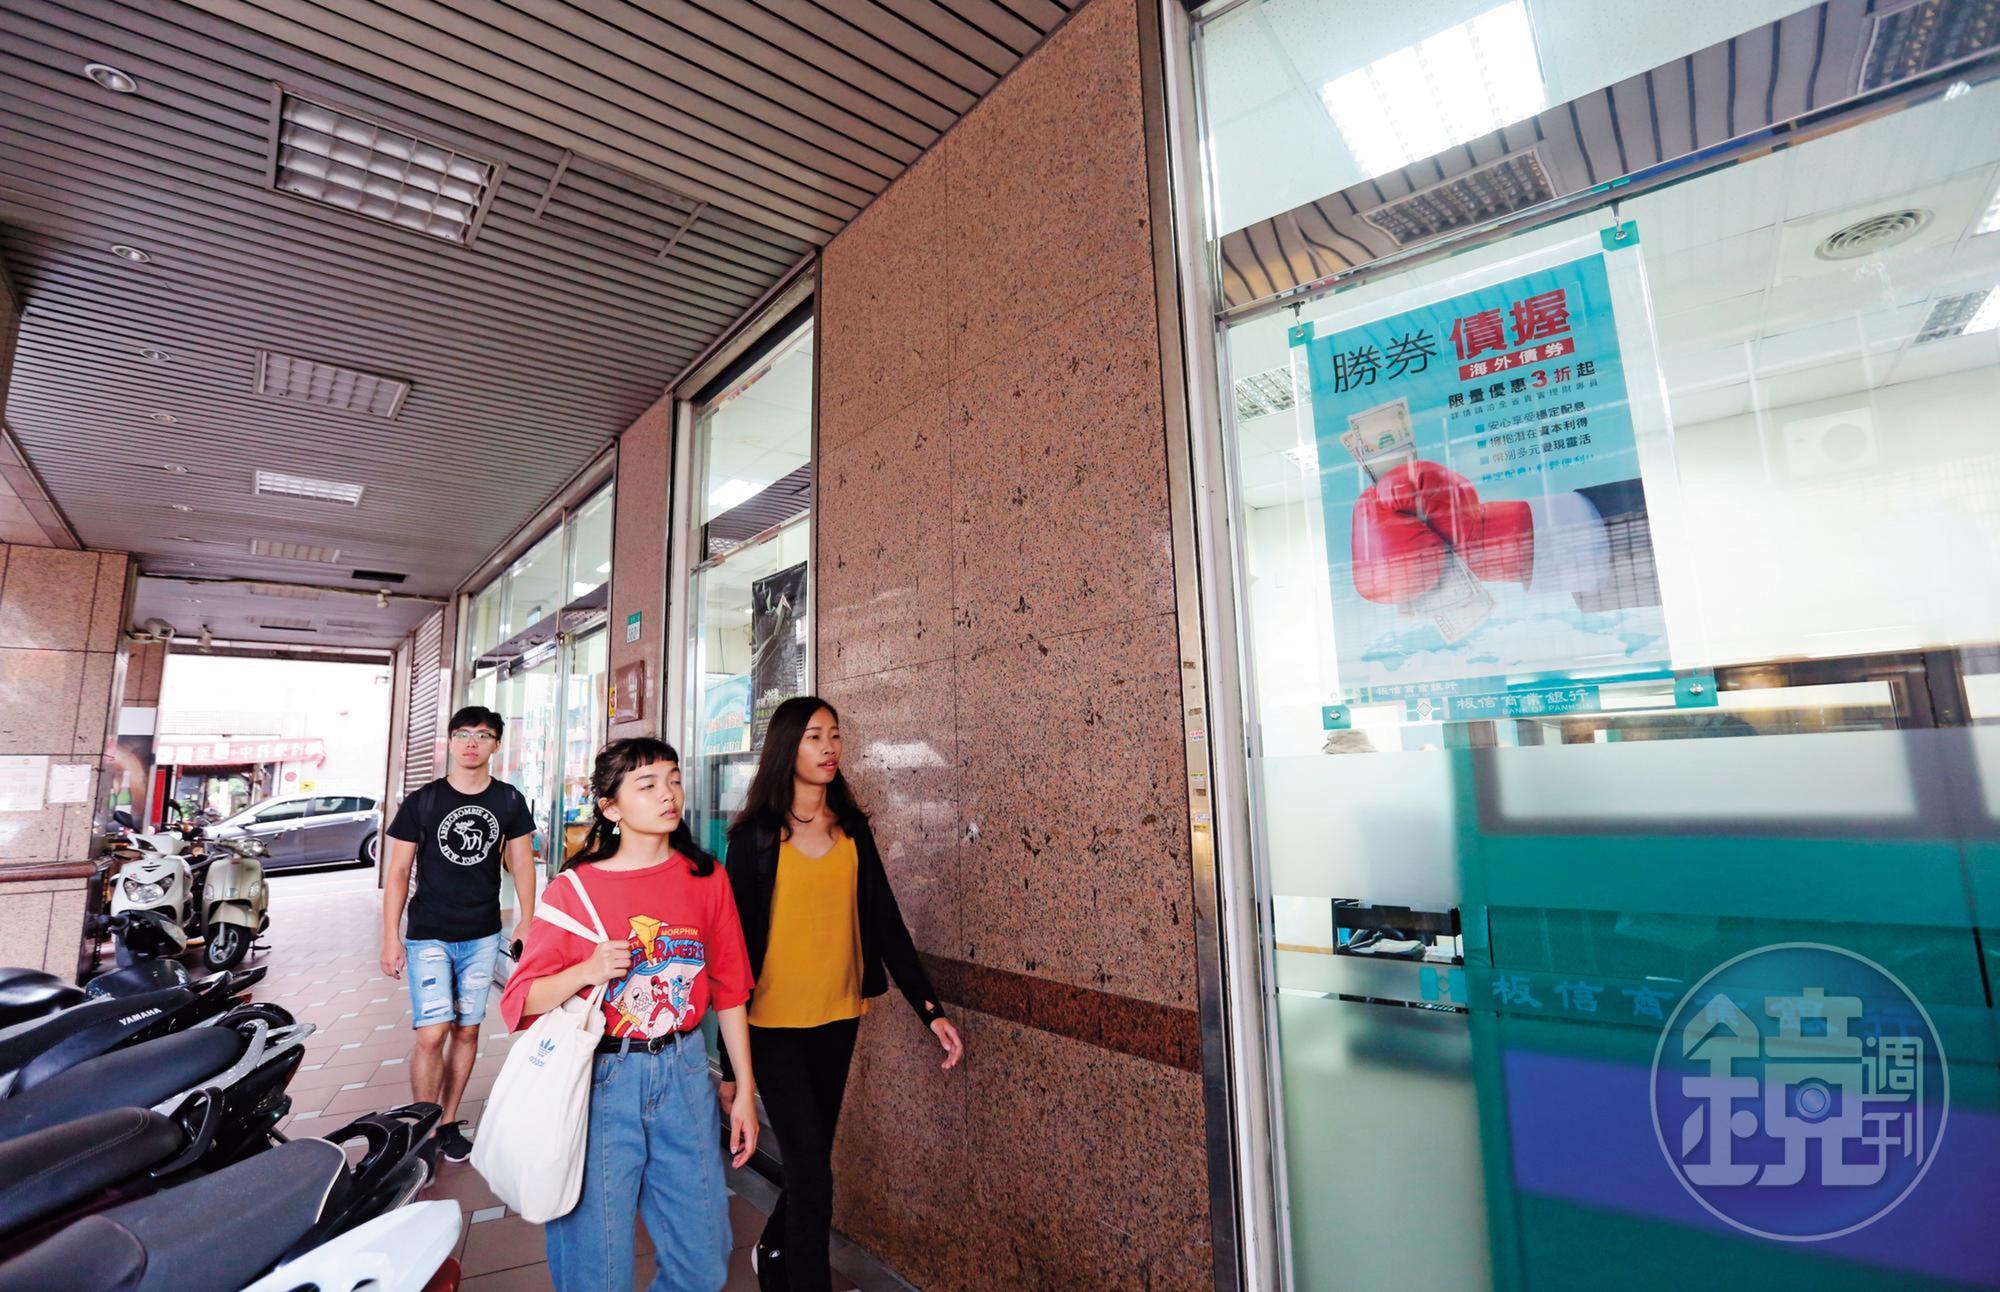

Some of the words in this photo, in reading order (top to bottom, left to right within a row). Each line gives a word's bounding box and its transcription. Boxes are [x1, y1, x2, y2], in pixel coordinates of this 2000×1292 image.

[1469, 343, 1566, 377] 海外債券
[1456, 689, 1589, 710] 板信商業銀行
[441, 844, 460, 861] NEW
[660, 927, 698, 937] MORPHIN
[118, 1007, 162, 1026] YAMAHA
